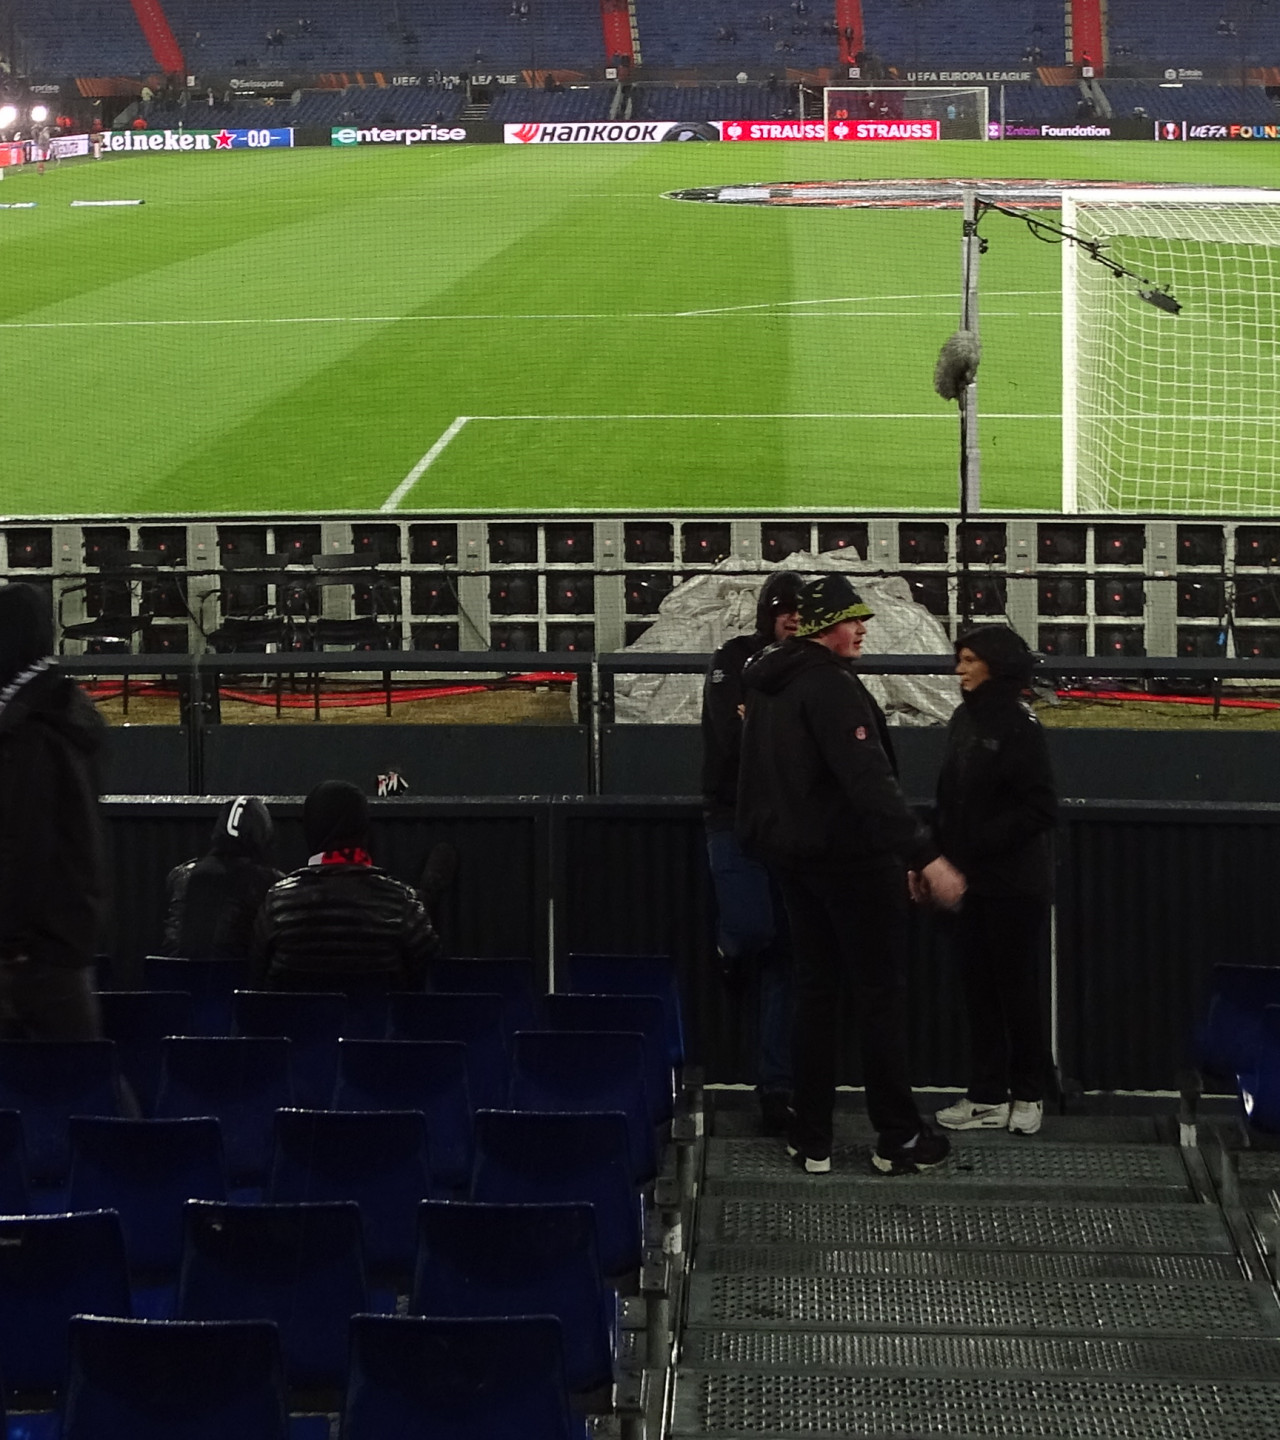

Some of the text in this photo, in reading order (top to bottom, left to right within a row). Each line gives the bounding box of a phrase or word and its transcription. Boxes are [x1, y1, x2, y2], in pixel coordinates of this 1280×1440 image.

[907, 72, 1032, 82] UEFA EUROPA LEAGUE
[332, 124, 467, 145] enterprise
[750, 124, 825, 138] STRAUSS
[857, 124, 932, 138] STRAUSS
[1041, 124, 1111, 137] Foundation
[1189, 125, 1228, 138] UEFA
